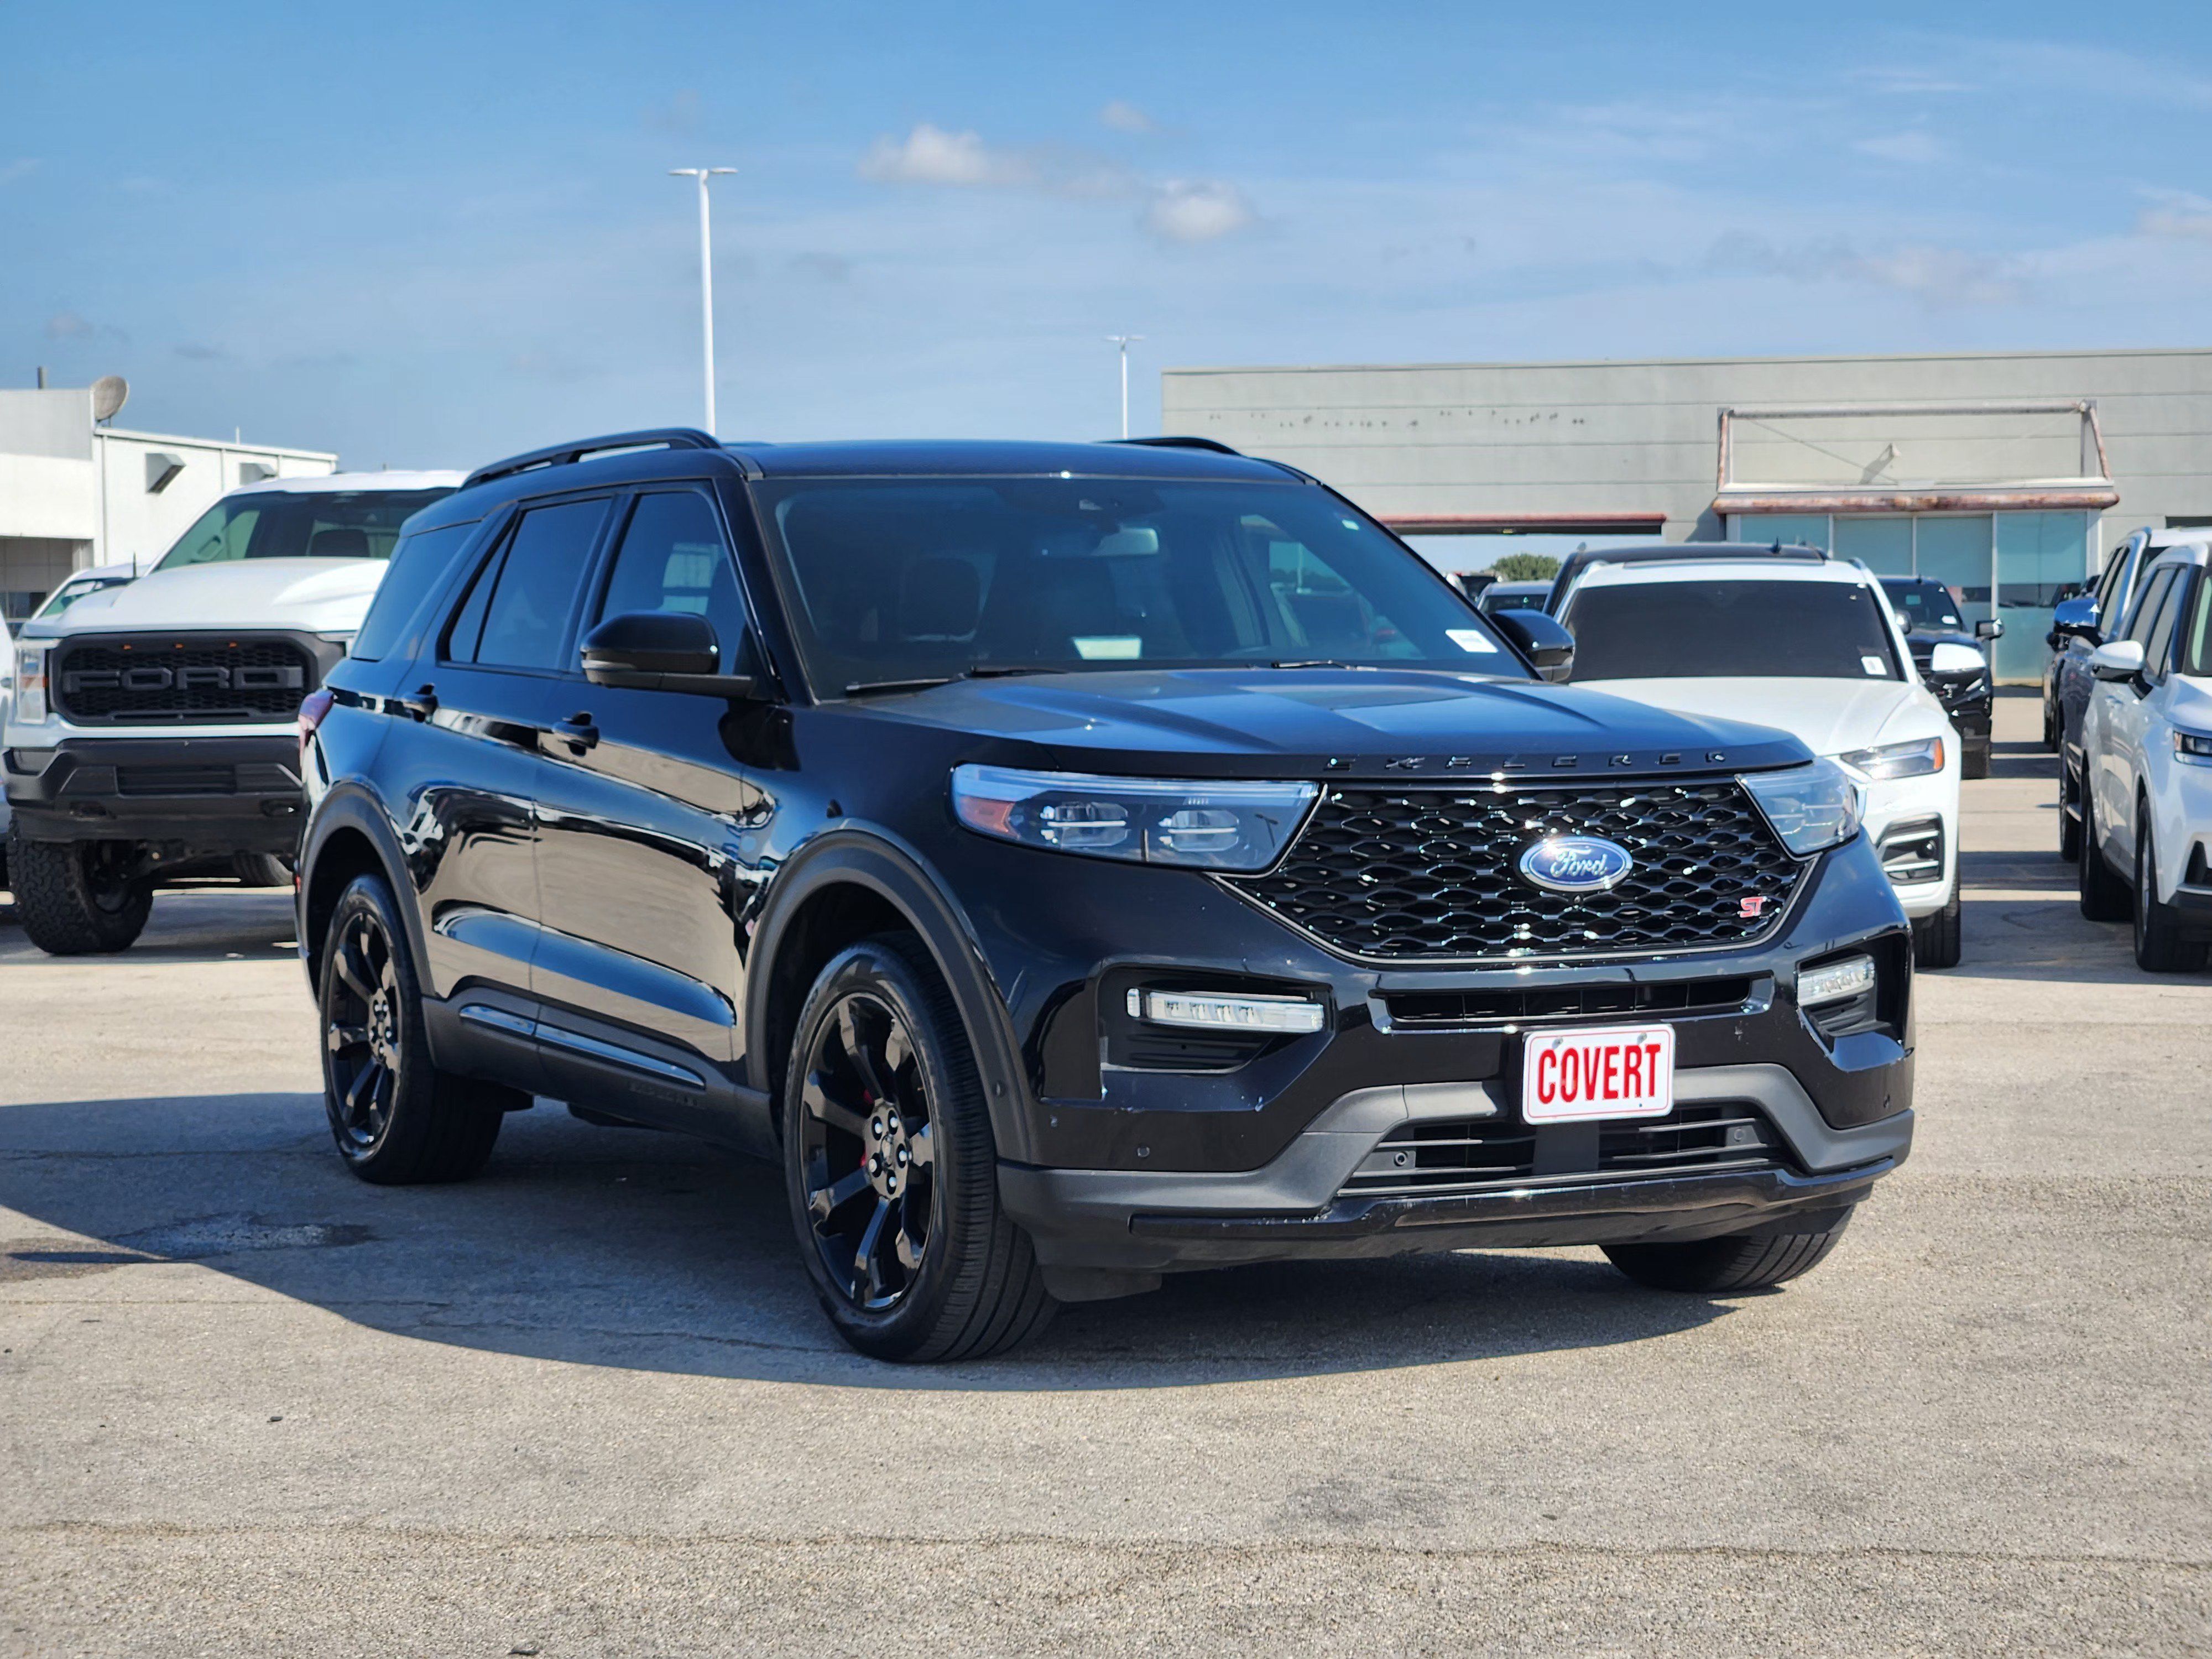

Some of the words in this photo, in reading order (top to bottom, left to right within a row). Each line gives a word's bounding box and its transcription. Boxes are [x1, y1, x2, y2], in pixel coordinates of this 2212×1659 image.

[62, 666, 304, 693] FORD
[1550, 847, 1608, 878] Ford
[1739, 896, 1768, 918] ST
[1537, 1043, 1662, 1104] COVERT
